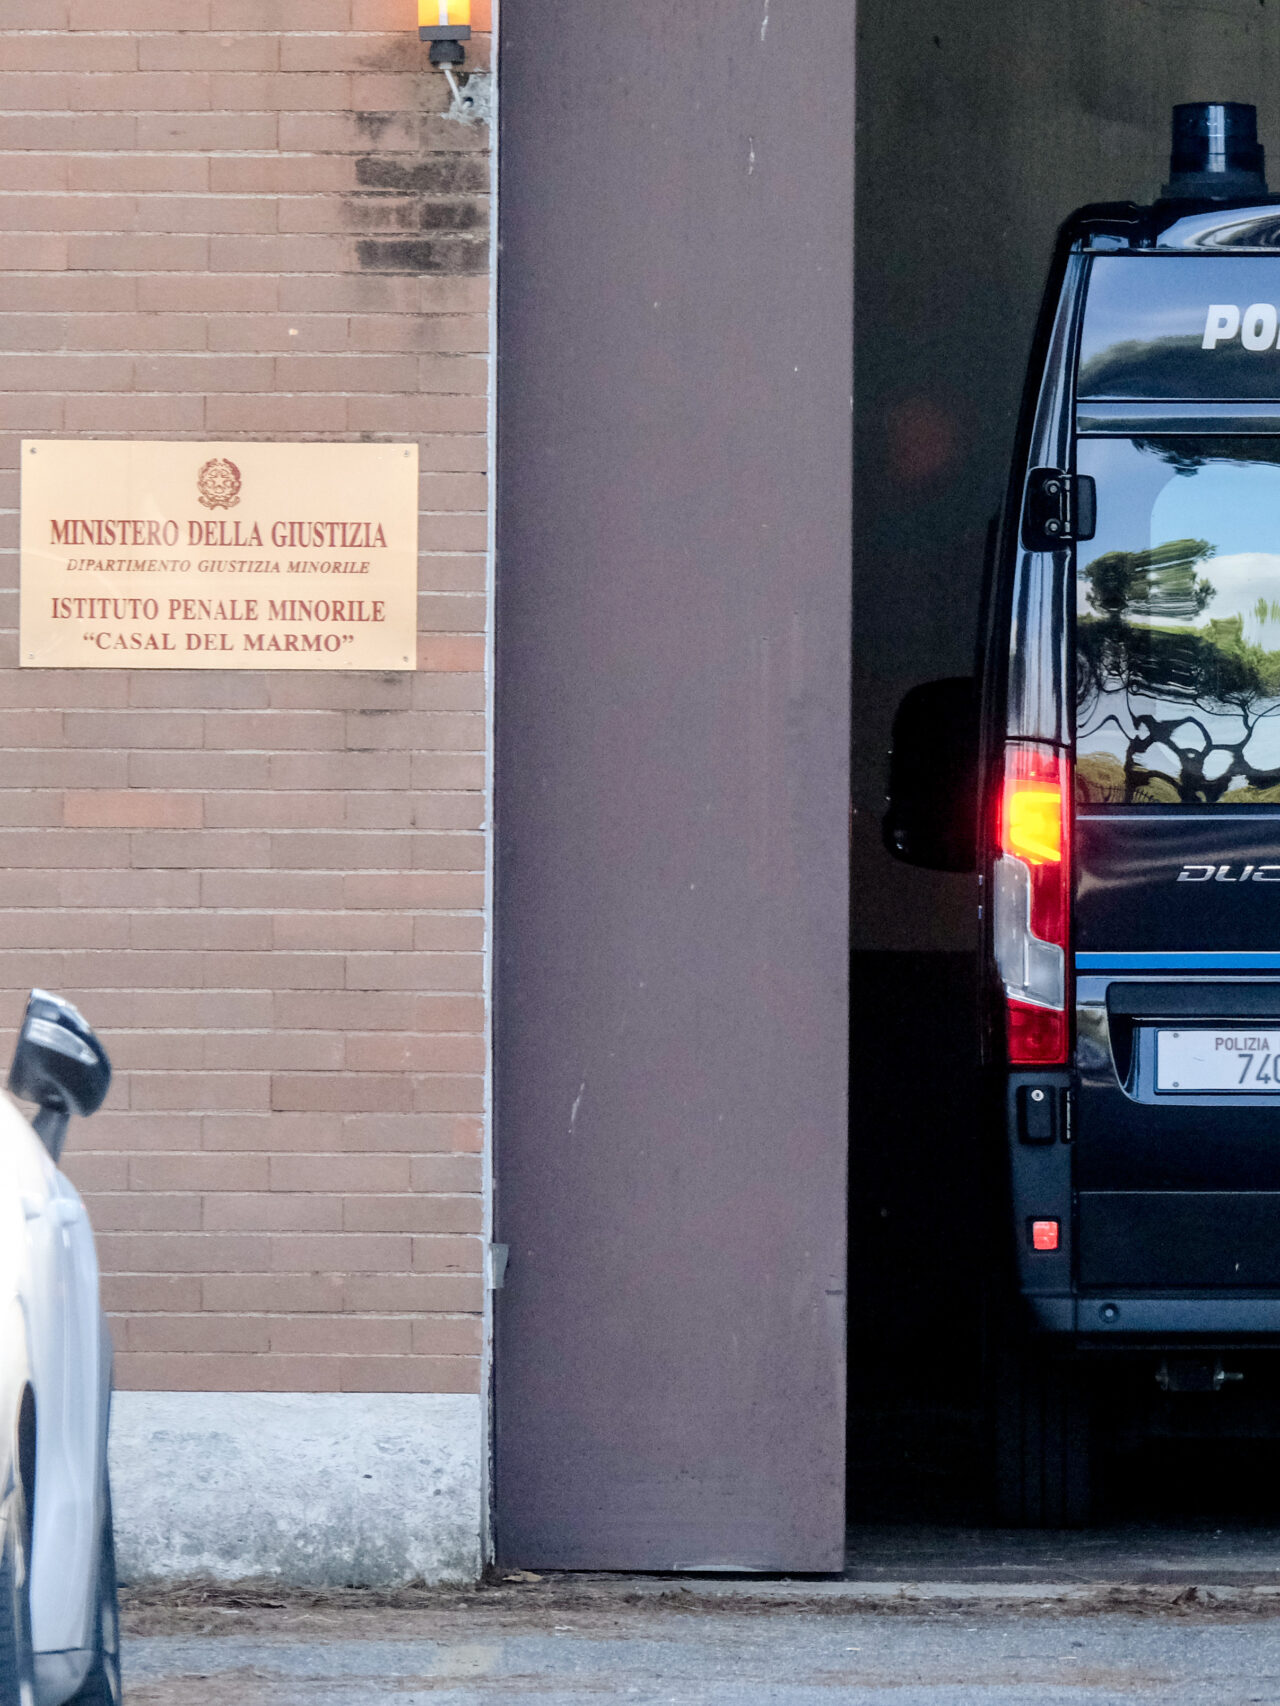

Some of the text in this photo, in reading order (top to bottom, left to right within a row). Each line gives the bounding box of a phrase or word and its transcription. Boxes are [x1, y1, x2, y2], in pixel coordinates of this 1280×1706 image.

[50, 519, 388, 548] MINISTERO DELLA GIUSTIZIA
[66, 558, 370, 574] DIPARTIMENTO GIUSTIZIA MINORILE
[51, 597, 386, 622] ISTITUTO PENALE MINORILE
[185, 632, 234, 651] DEL
[1215, 1037, 1270, 1051] POLIZIA
